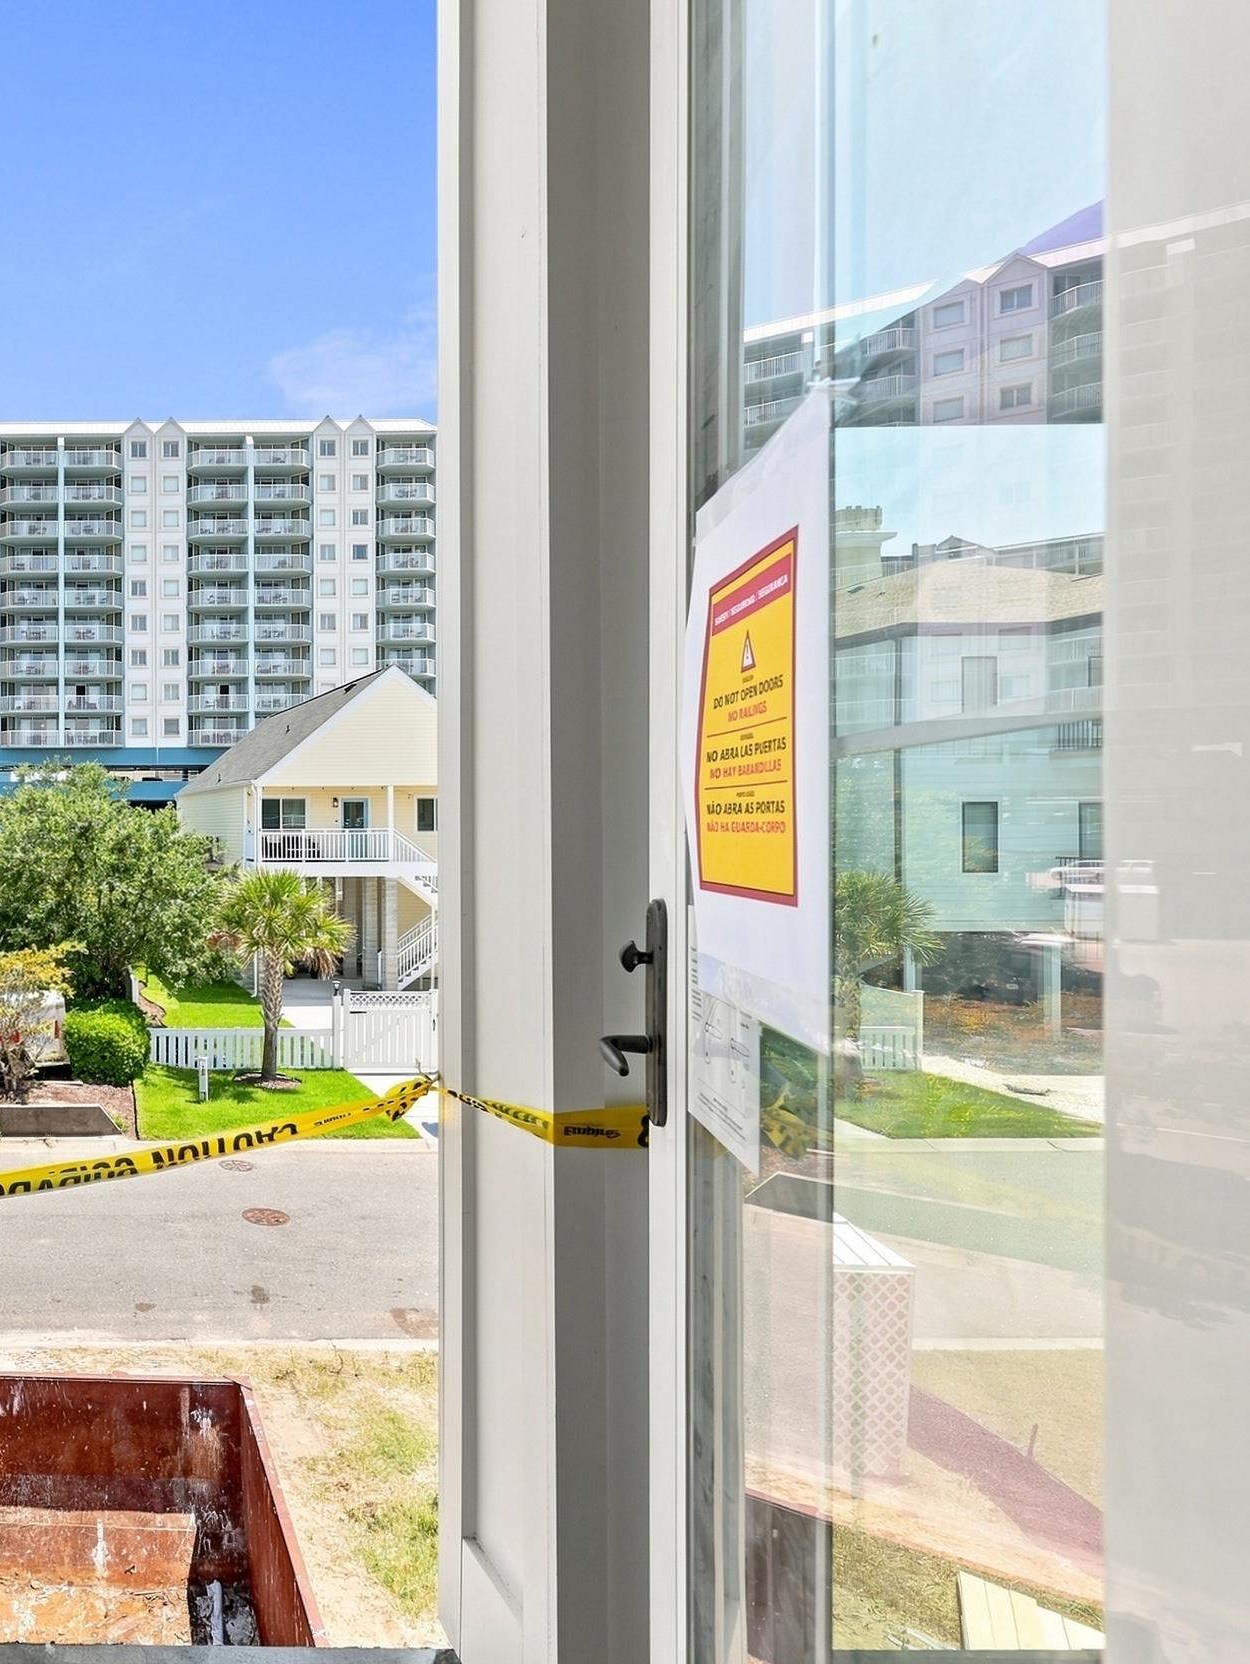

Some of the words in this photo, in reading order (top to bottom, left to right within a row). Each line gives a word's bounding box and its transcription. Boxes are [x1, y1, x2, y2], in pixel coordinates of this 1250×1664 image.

[713, 696, 724, 710] DO
[724, 690, 739, 706] NOT
[740, 684, 758, 701] OPEN
[758, 674, 784, 695] DOORS
[728, 710, 738, 722] NO
[739, 700, 767, 719] RAILINGS
[706, 750, 719, 763] NO
[719, 746, 739, 761] ABRA
[740, 743, 753, 758] LAS
[754, 736, 787, 755] PUERTAS
[709, 767, 721, 779] NO
[722, 766, 737, 778] HAY
[738, 758, 782, 777] BARANDILLAS
[723, 802, 743, 815] ABRA
[744, 801, 755, 814] AS
[755, 800, 785, 814] PORTAS
[731, 820, 787, 833] GUARDA-CORPO
